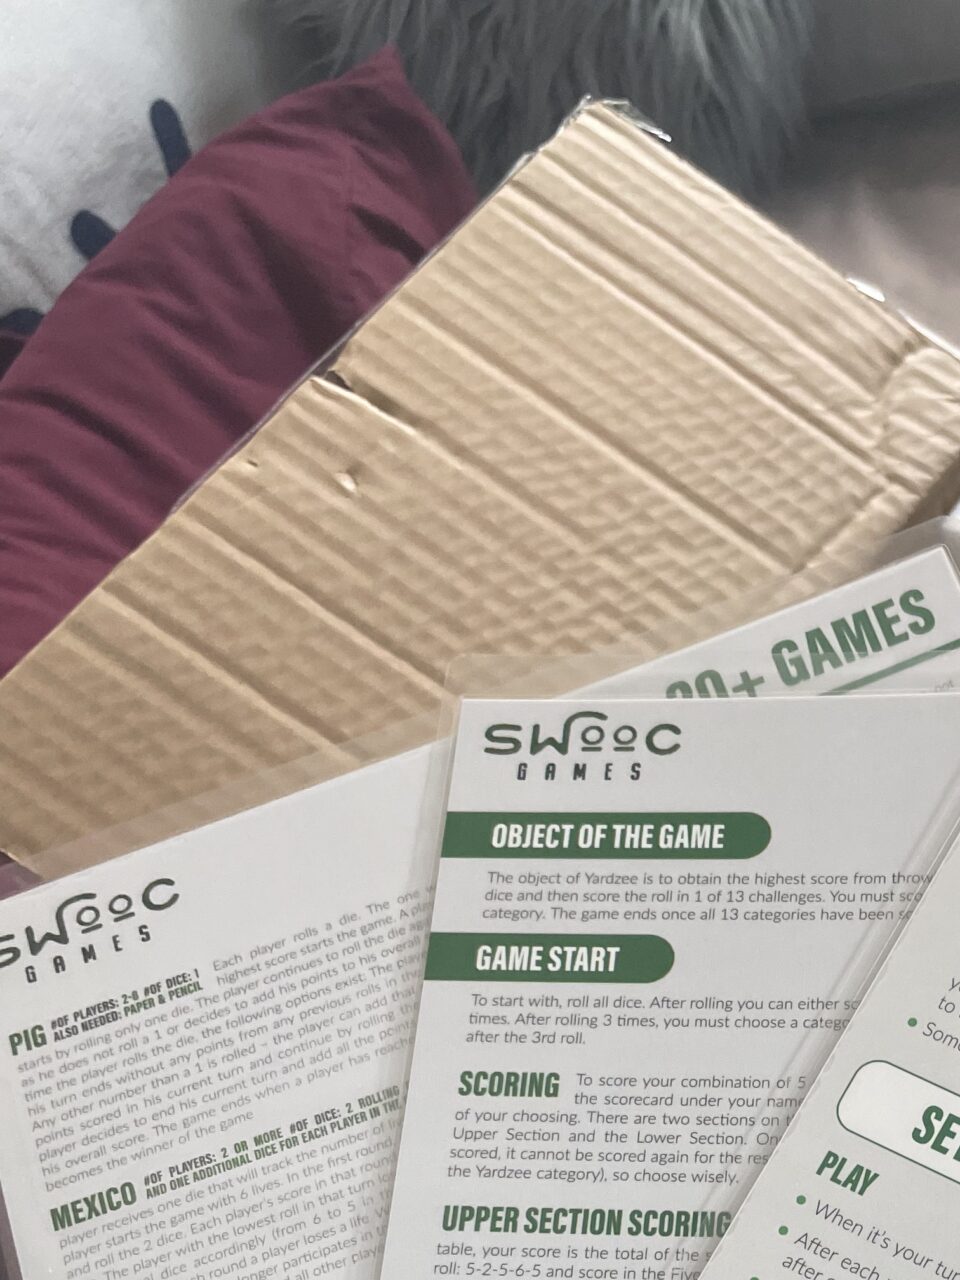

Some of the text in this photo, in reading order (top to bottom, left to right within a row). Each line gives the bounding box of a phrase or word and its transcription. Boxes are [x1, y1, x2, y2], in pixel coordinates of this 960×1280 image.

[770, 588, 936, 686] GAMES
[517, 762, 642, 781] GAMES
[491, 823, 725, 849] OBJECT OF THE GAME
[25, 925, 152, 984] GAMES
[476, 945, 621, 972] GAME START
[50, 968, 200, 1030] #OF PLAYERS: 2-8 #OF DICE: 1
[53, 980, 204, 1043] ALSO NEEDED: PAPER & PENCIL
[8, 1022, 50, 1057] PIG
[465, 1030, 586, 1045] after the 3rd roll.
[457, 1070, 560, 1098] SCORING
[447, 1164, 739, 1186] the Yardzee category), so choose wisely.
[815, 1150, 880, 1197] PLAY
[50, 1181, 137, 1231] MEXICO
[442, 1205, 732, 1238] UPPER SECTION SCORING
